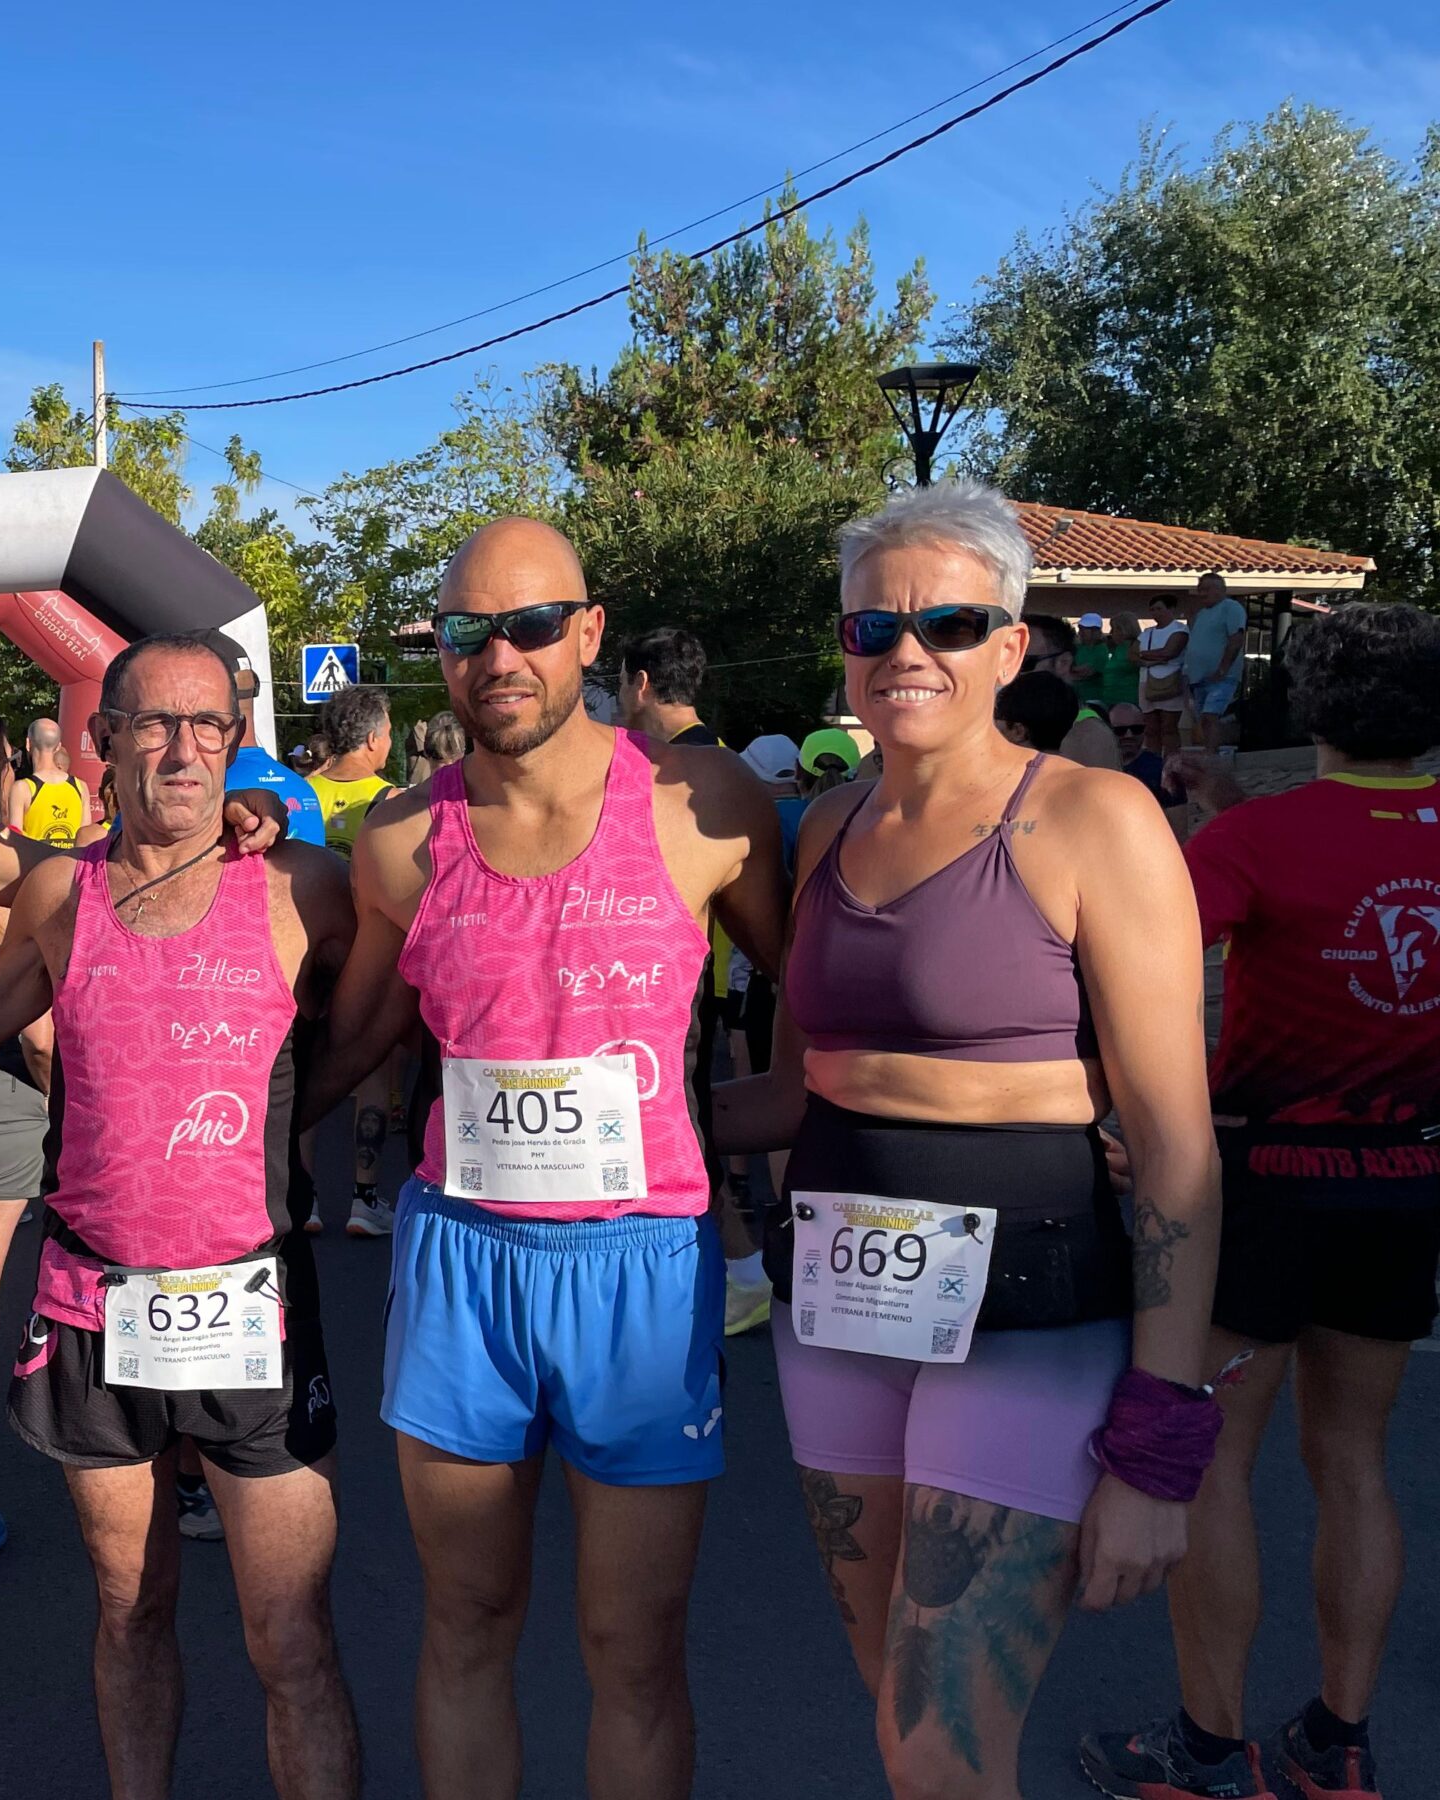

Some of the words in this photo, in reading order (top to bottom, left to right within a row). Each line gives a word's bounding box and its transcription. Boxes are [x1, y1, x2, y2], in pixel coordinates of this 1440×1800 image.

[34, 610, 67, 641] CIUDAD
[65, 640, 87, 662] REAL
[450, 912, 488, 928] TACTIC
[1343, 896, 1374, 938] CLUB
[1320, 948, 1379, 961] CIUDAD
[87, 965, 119, 977] TACTIC
[482, 1067, 530, 1078] CARRERA
[530, 1066, 583, 1077] POPULAR
[486, 1089, 584, 1135] 405
[164, 1100, 230, 1161] phi
[491, 1138, 510, 1146] Pedro
[553, 1138, 562, 1146] de
[496, 1163, 533, 1171] VETERANO
[541, 1162, 585, 1170] MASCULINO
[1248, 1145, 1359, 1178] QUINTO
[832, 1202, 878, 1216] CARRERA
[879, 1205, 935, 1222] POPULAR
[830, 1226, 928, 1282] 669
[145, 1273, 188, 1284] CARRERA
[189, 1271, 232, 1283] POPULAR
[835, 1279, 854, 1288] Esther
[855, 1281, 882, 1292] Alguacil
[883, 1284, 914, 1296] Señoret
[865, 1296, 910, 1309] Miguelturra
[148, 1291, 231, 1332] 632
[831, 1306, 864, 1317] VETERANA
[871, 1311, 913, 1323] FEMENINO
[180, 1343, 221, 1353] polideportivo
[153, 1355, 186, 1363] VETERANO
[193, 1354, 231, 1362] MASCULINO
